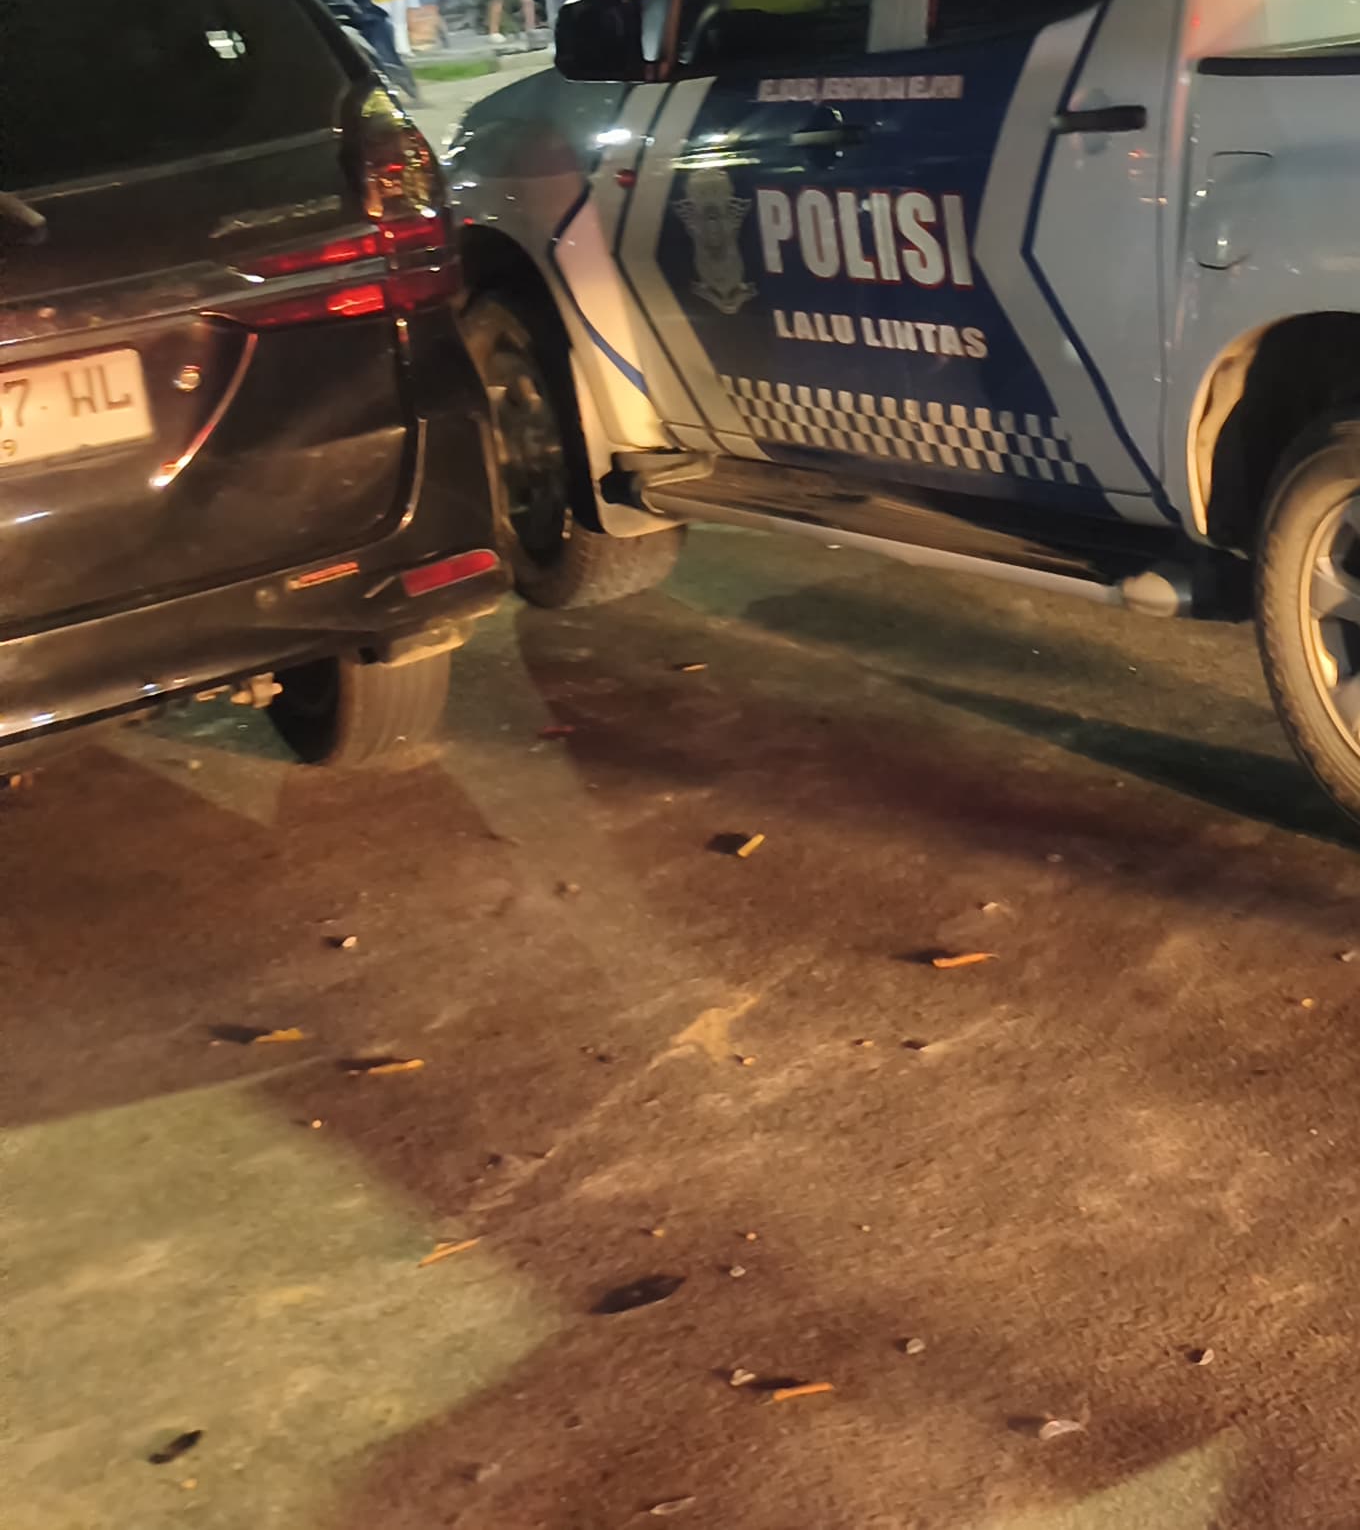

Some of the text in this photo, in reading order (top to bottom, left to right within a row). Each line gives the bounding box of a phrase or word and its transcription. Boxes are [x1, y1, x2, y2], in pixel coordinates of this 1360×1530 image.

[756, 187, 975, 290] POLISI
[772, 309, 989, 360] LALU LINTAS
